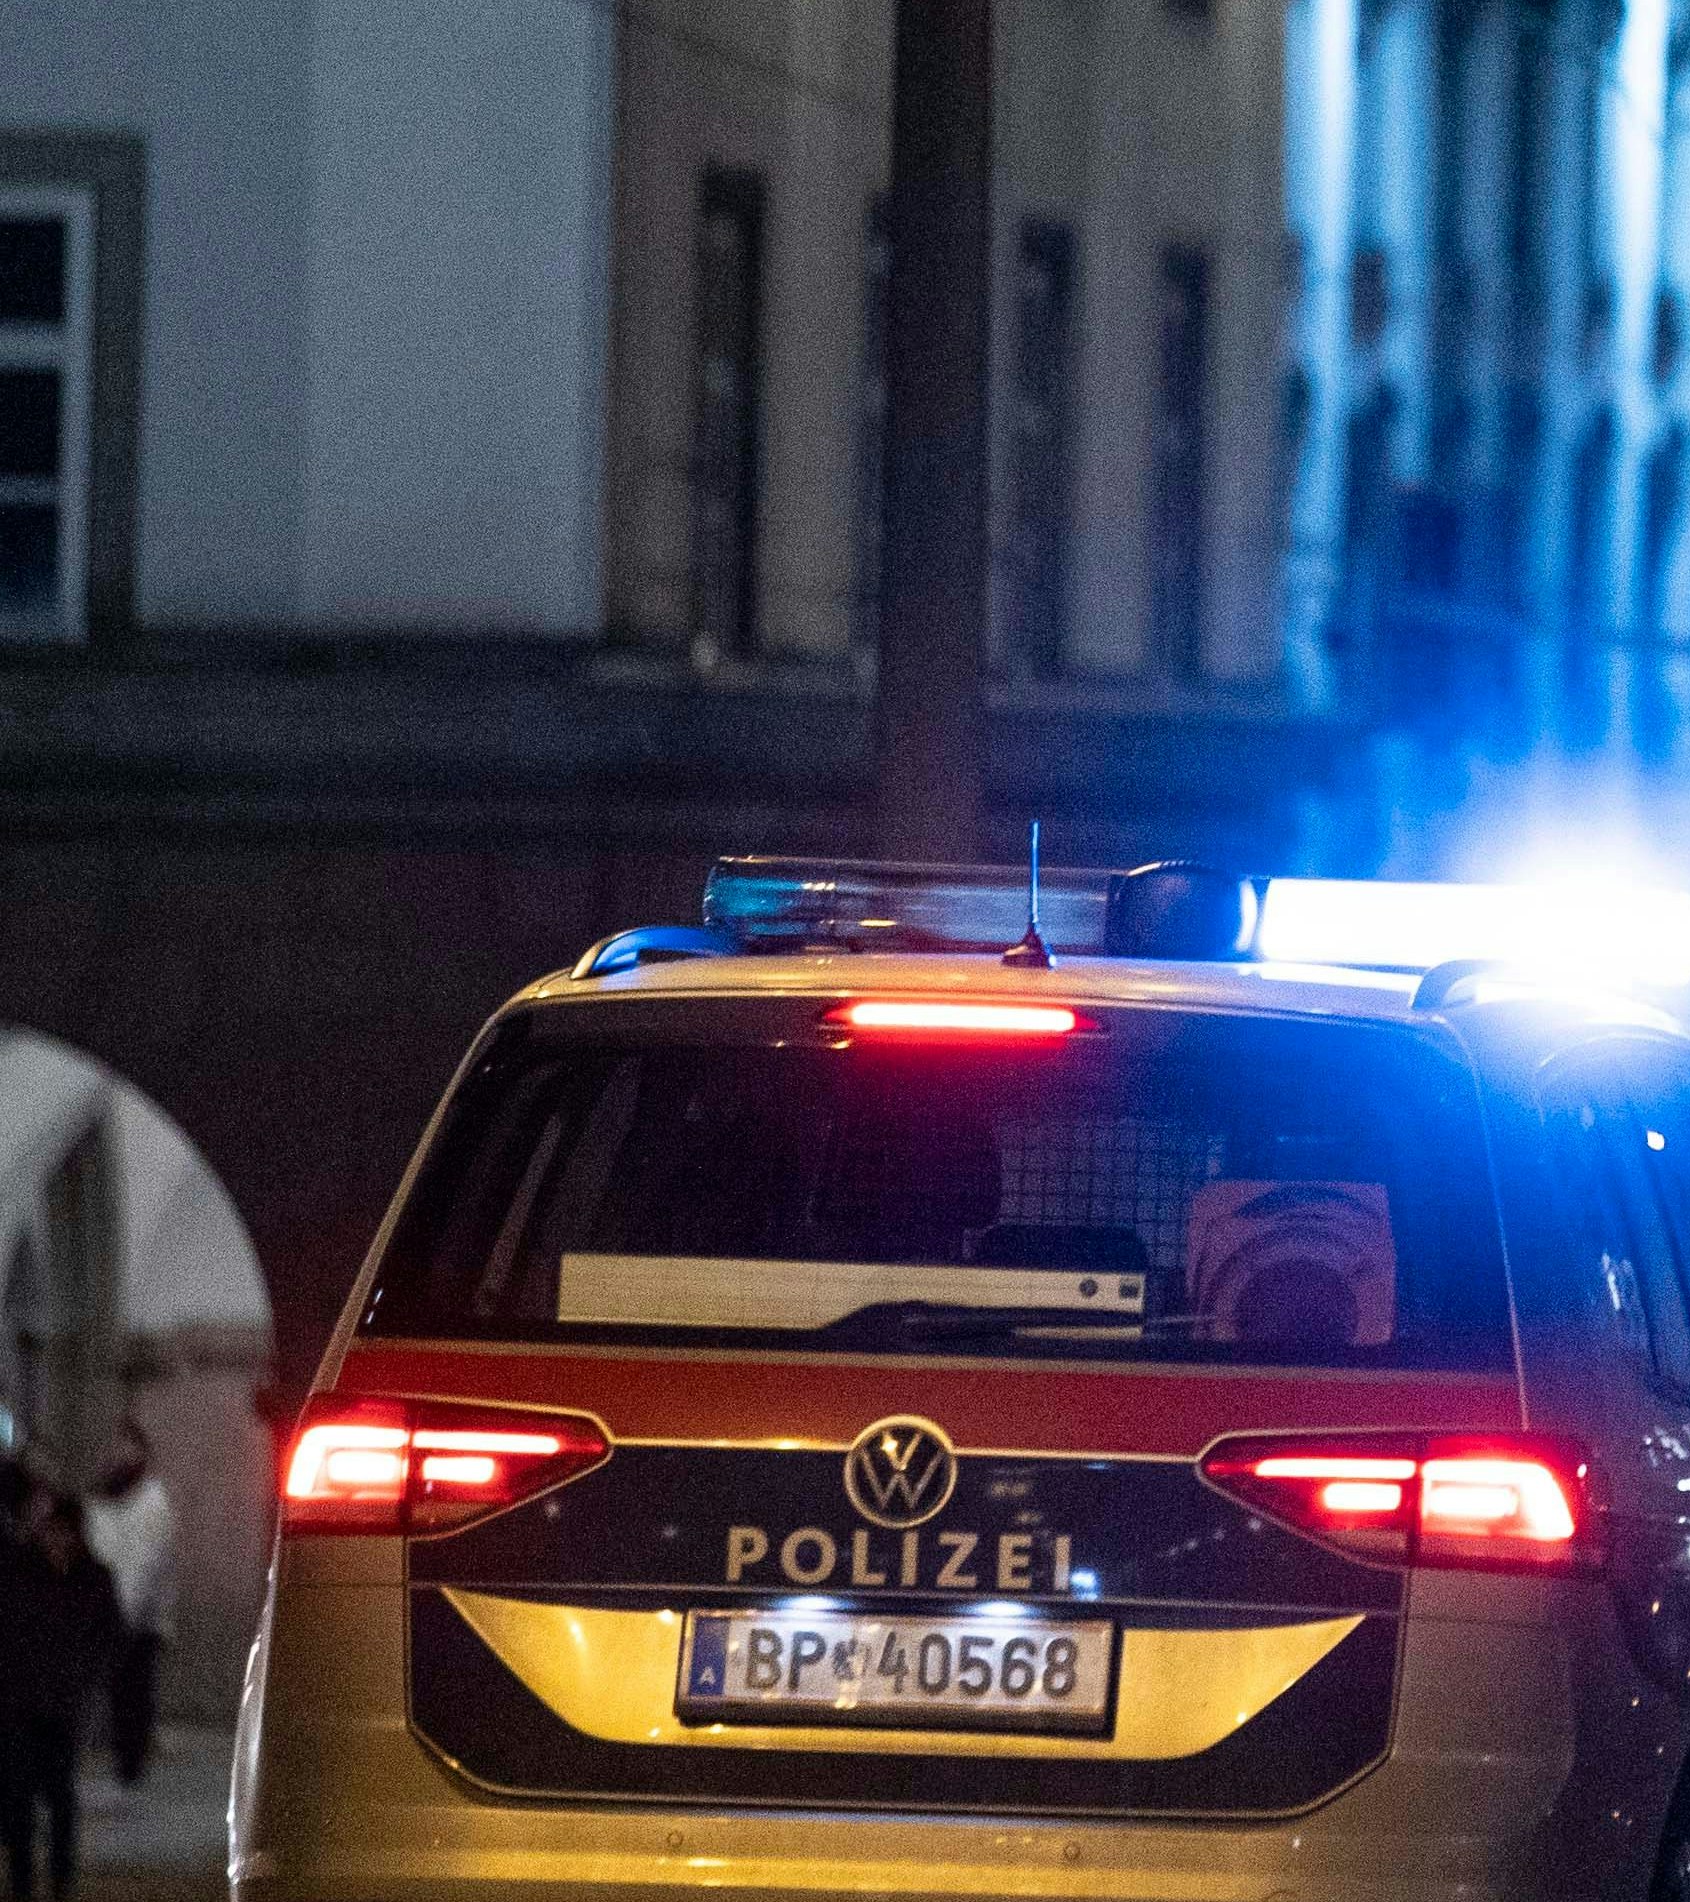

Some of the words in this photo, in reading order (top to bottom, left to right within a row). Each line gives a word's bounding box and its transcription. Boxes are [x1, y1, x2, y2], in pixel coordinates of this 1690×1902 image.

[856, 1428, 946, 1512] VW
[725, 1525, 1073, 1592] POLIZEI
[744, 1627, 827, 1694] BP
[876, 1630, 1081, 1701] 40568
